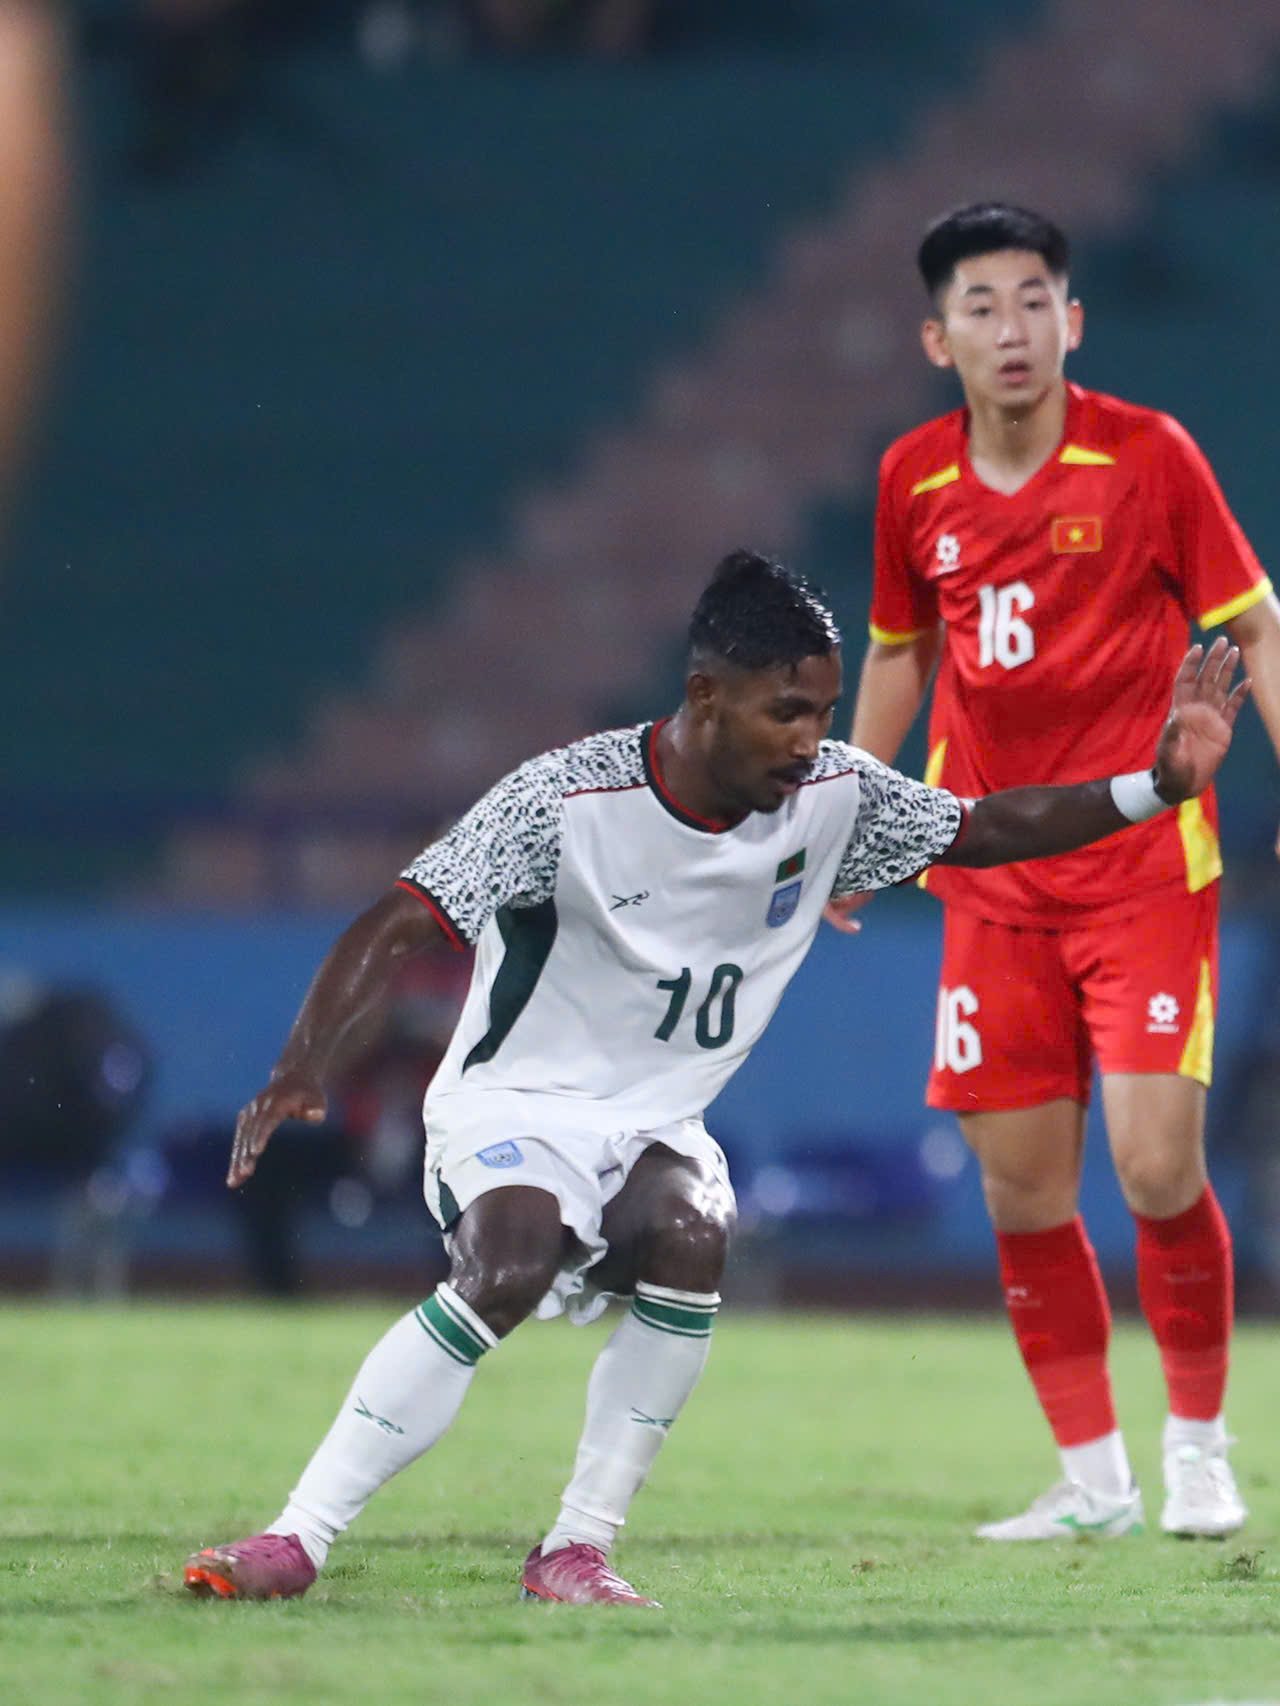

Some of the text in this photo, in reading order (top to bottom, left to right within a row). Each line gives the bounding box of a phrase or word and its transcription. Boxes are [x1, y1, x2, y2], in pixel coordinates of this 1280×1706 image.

[977, 581, 1035, 670] 16
[654, 963, 744, 1050] 10
[934, 985, 982, 1074] 16
